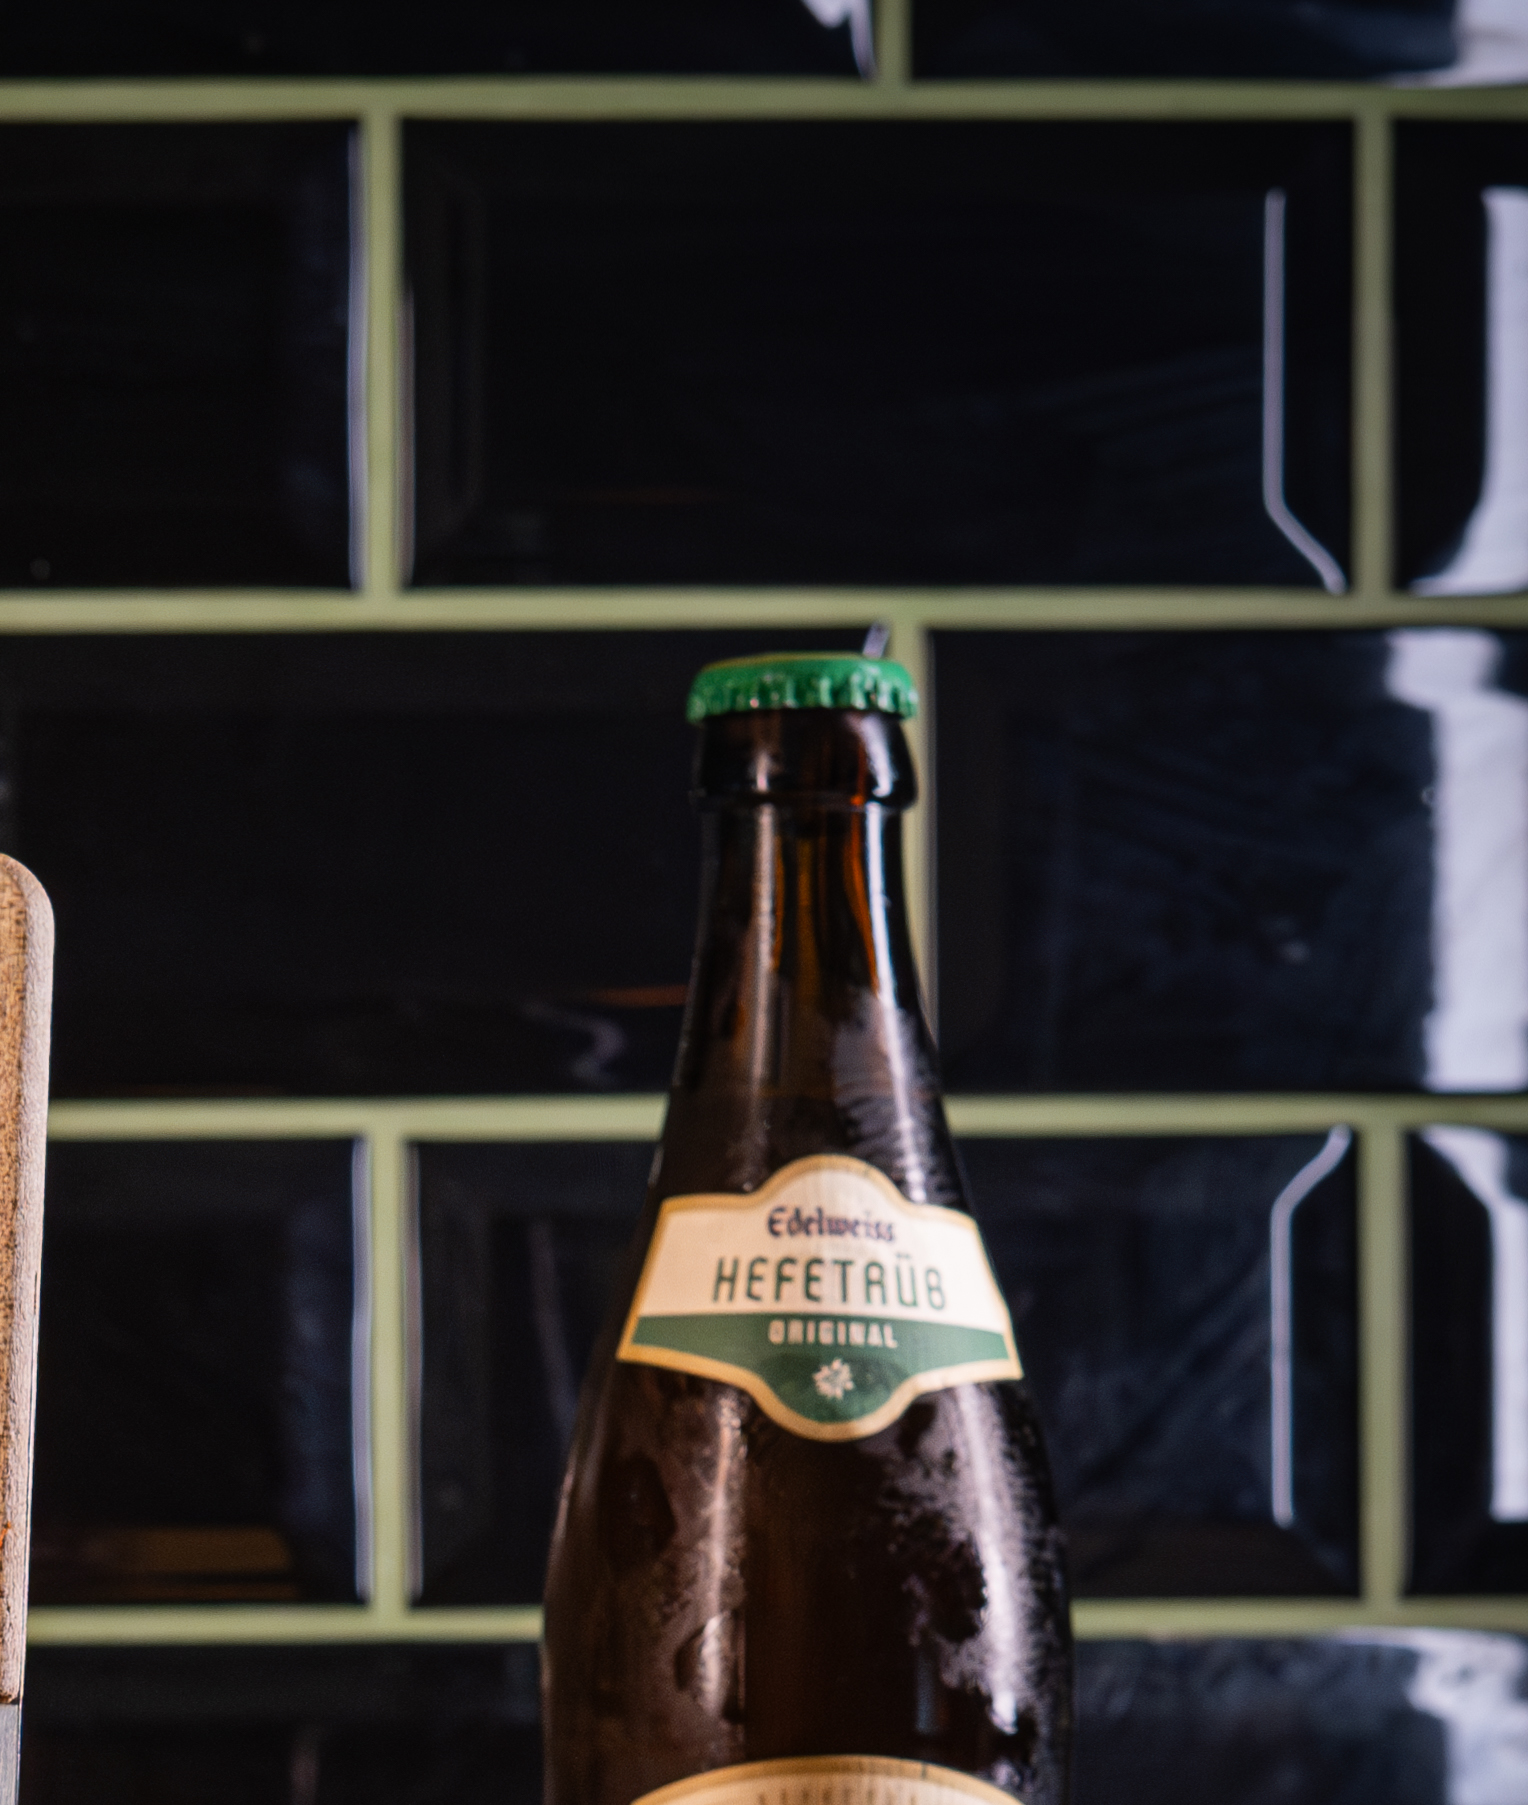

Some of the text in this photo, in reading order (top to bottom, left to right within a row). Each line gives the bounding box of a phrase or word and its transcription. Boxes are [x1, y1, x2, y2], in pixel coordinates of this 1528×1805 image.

[767, 1205, 896, 1242] Edelweiss
[712, 1252, 946, 1310] HEFETRÜB
[768, 1318, 899, 1349] ORIGINAL
